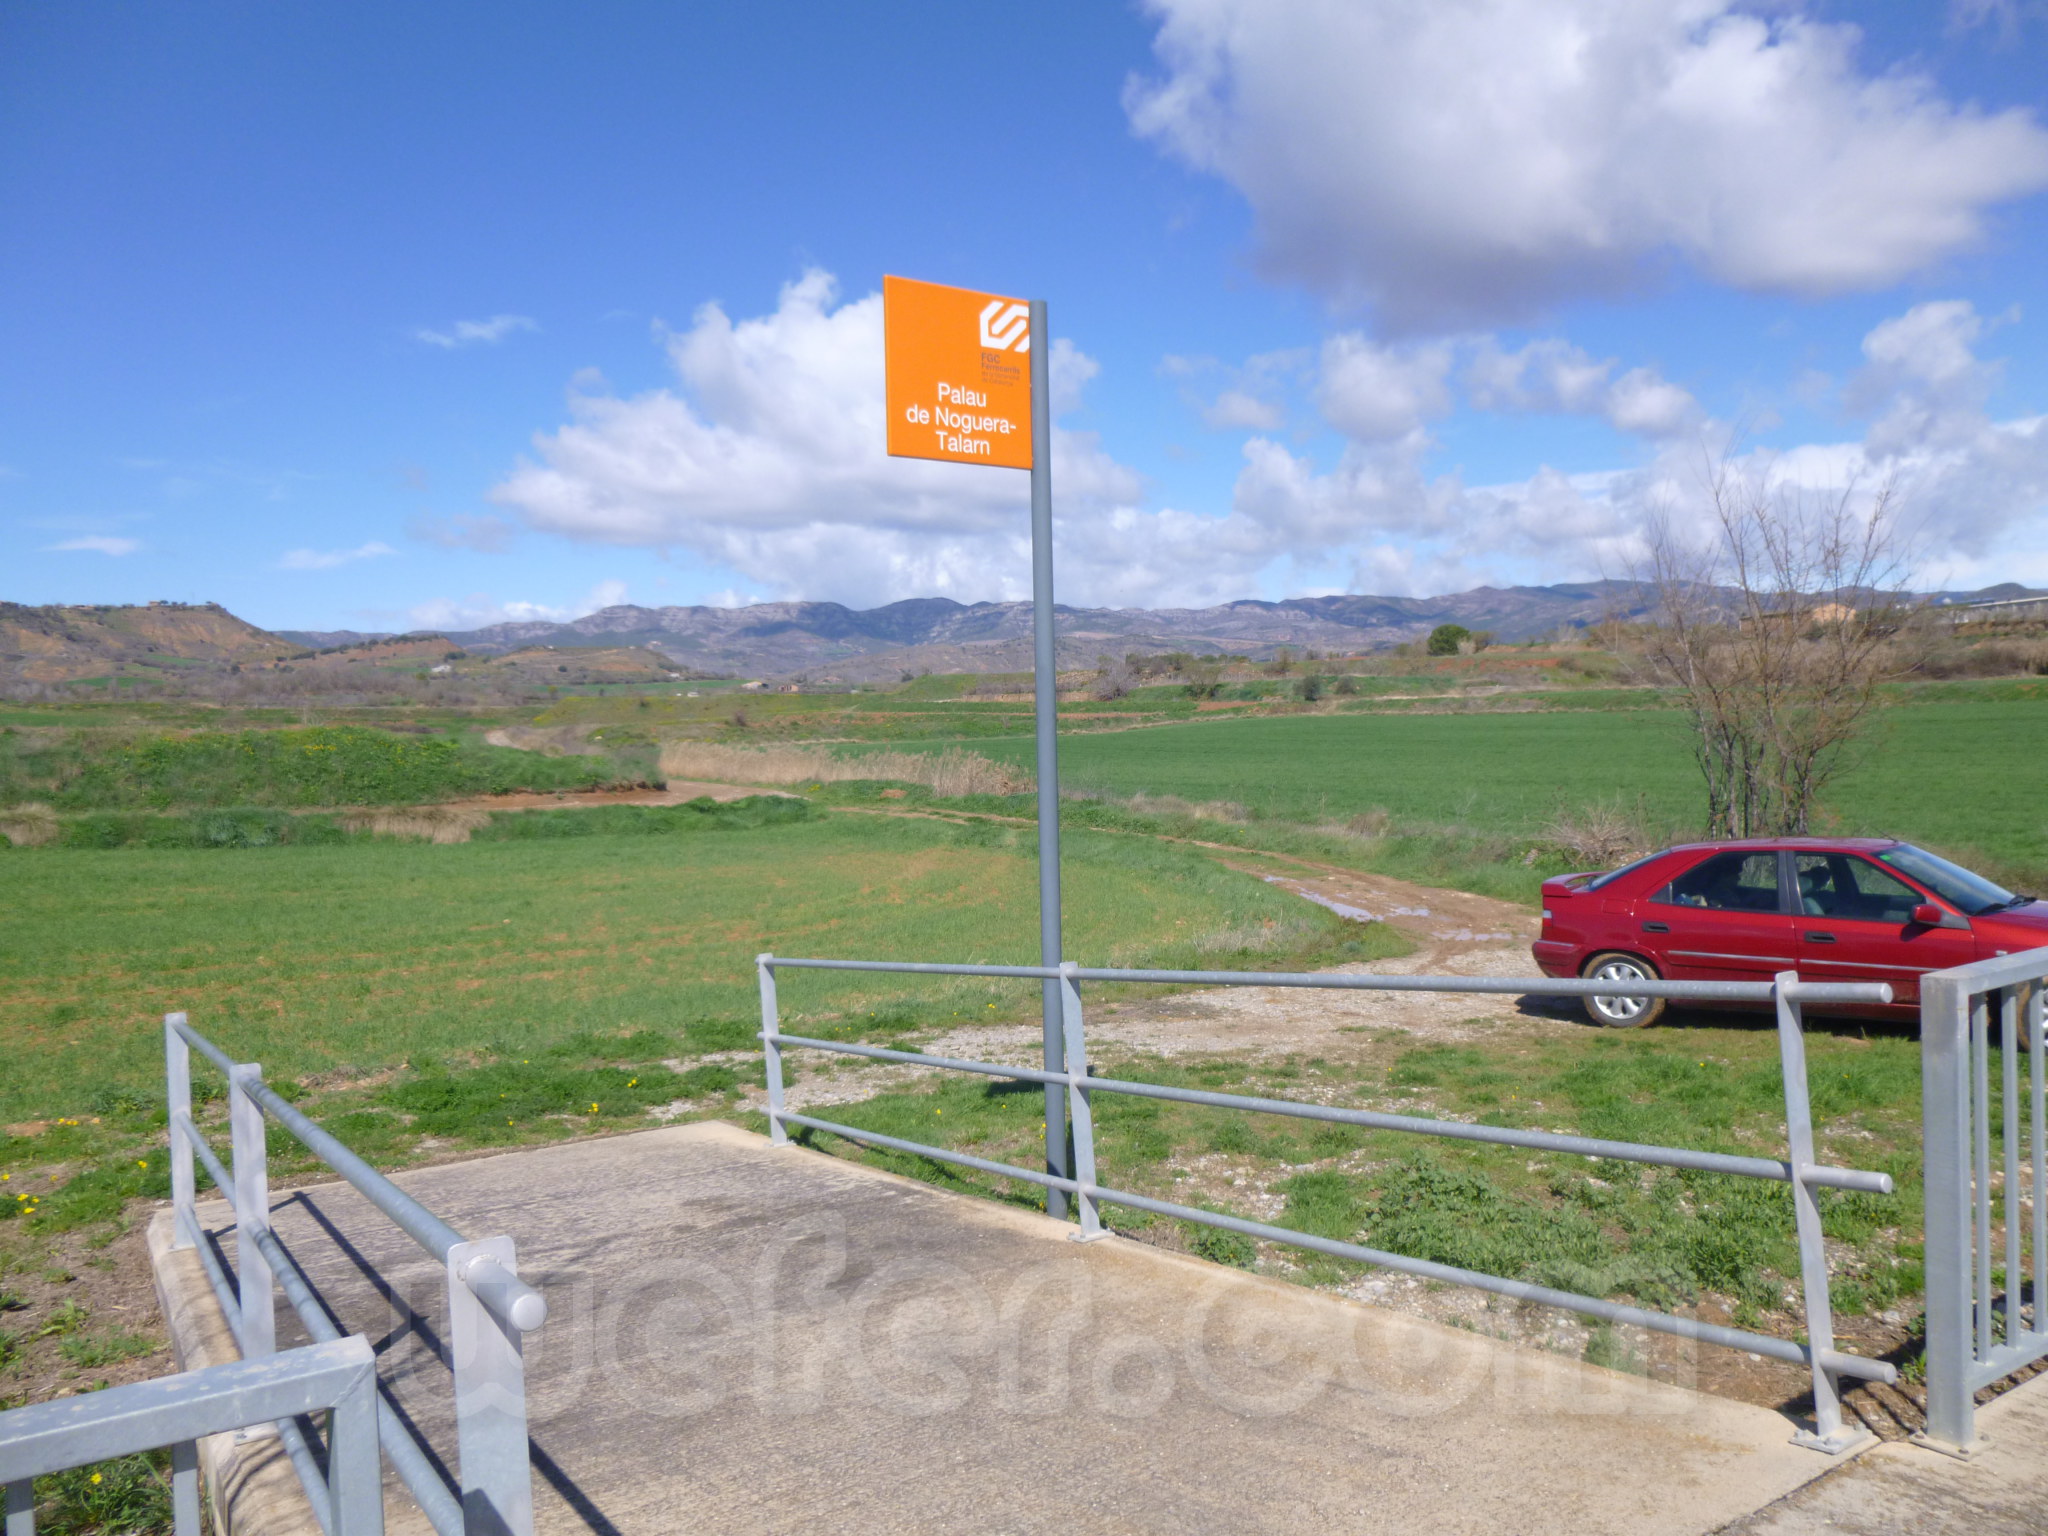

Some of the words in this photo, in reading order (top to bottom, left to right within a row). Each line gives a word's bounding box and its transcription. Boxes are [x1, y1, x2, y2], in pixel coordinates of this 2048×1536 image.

[981, 352, 1000, 364] FGC
[938, 382, 987, 407] Palau
[906, 404, 930, 425] de
[936, 407, 1017, 434] Noguera-
[935, 431, 990, 455] Talarn
